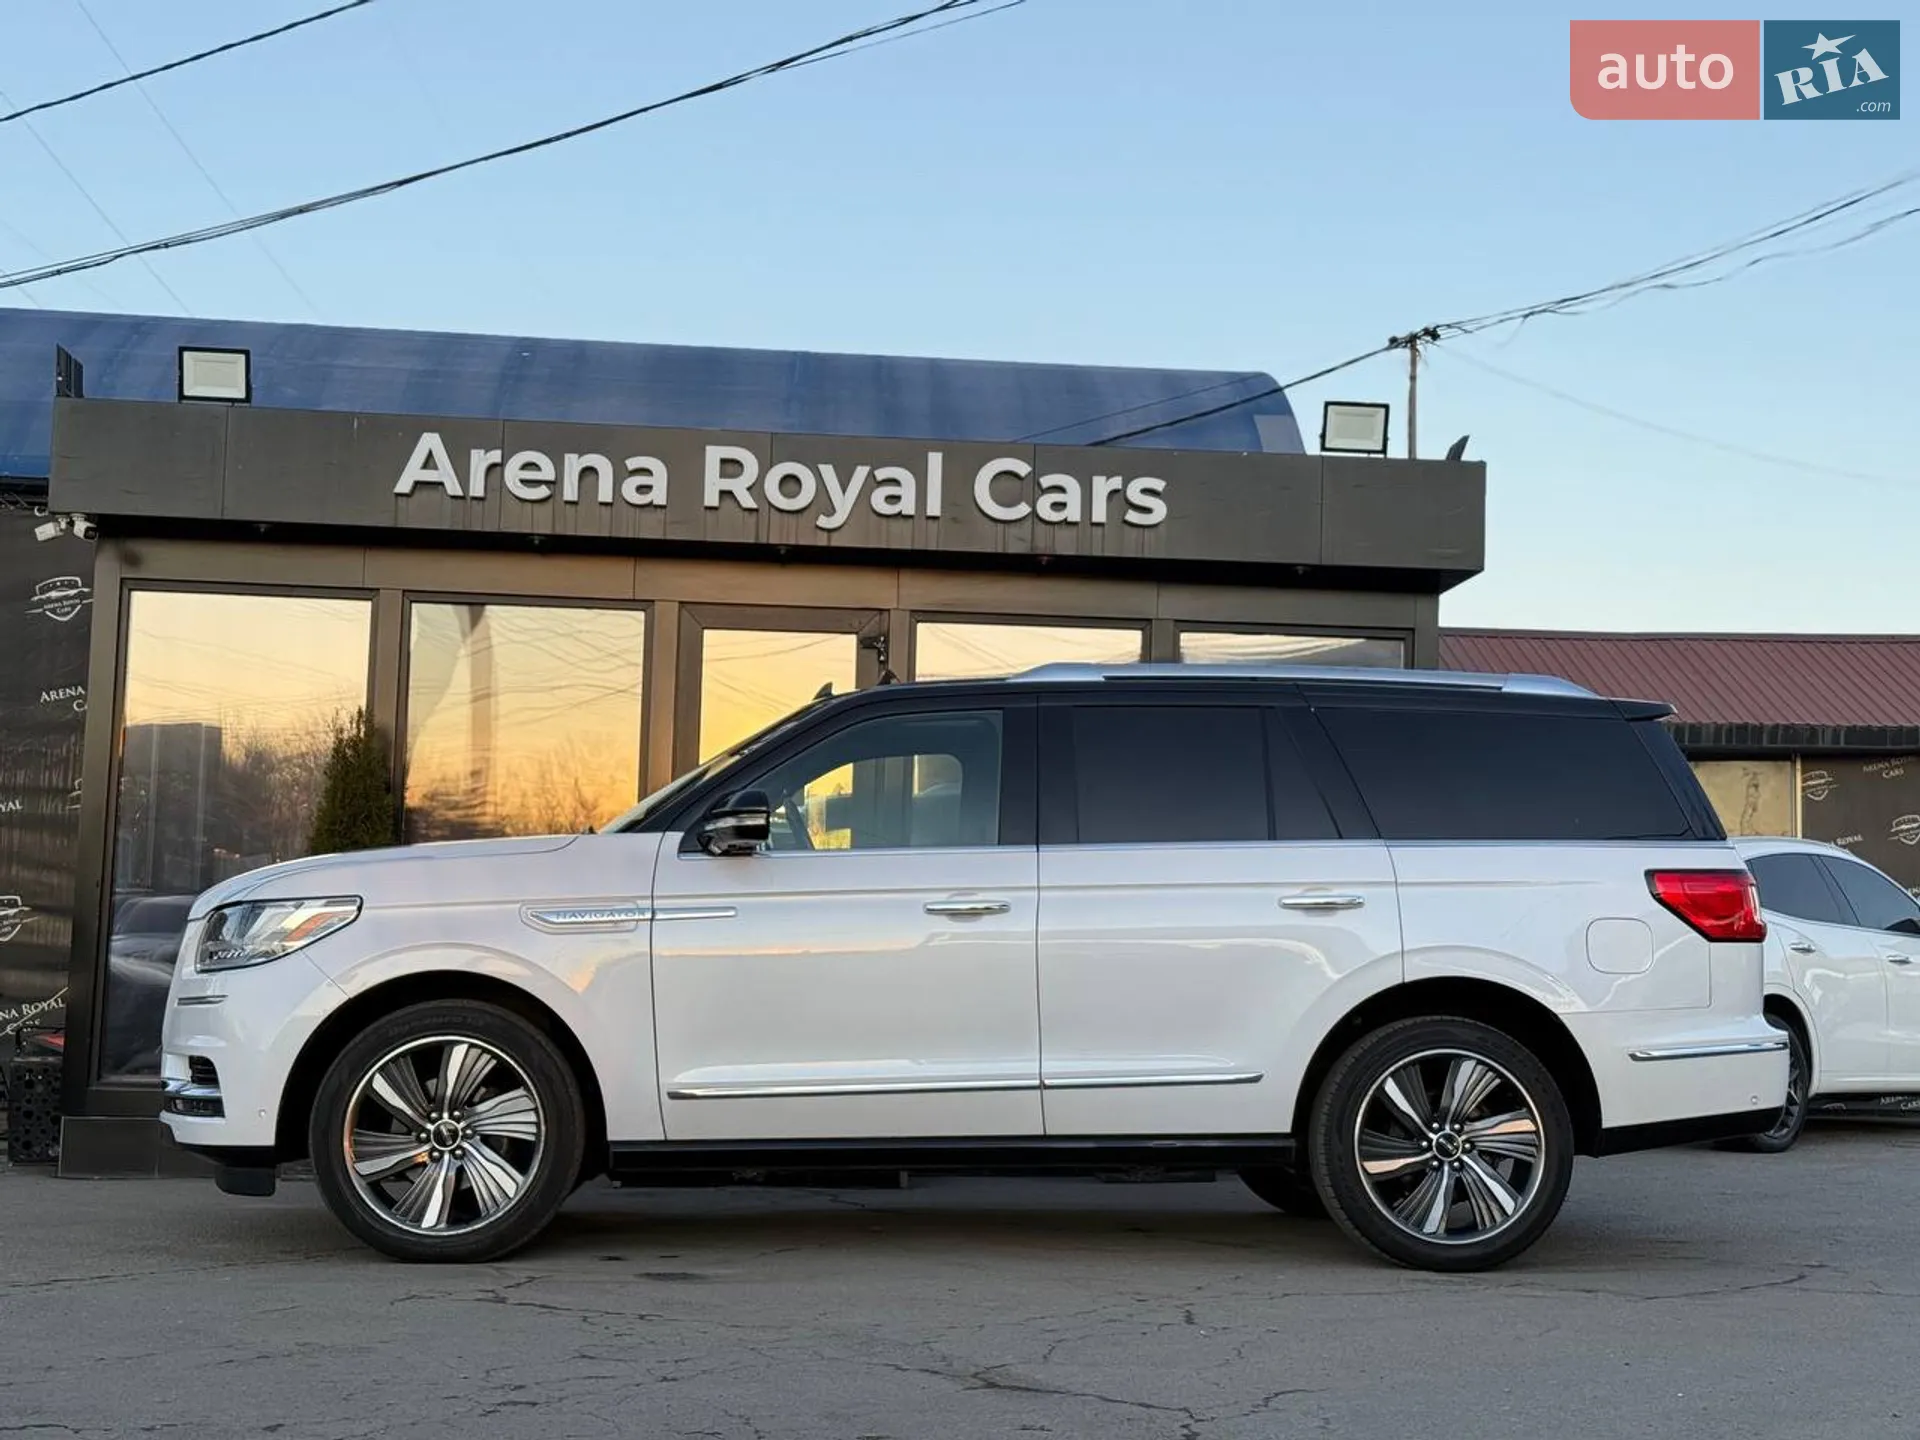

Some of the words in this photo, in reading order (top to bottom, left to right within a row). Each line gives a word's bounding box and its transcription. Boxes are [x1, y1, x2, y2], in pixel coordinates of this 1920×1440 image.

[393, 432, 668, 507] Arena
[703, 445, 944, 532] Royal
[973, 457, 1168, 527] Cars
[40, 685, 86, 703] ARENA
[556, 908, 649, 920] NAVIGATOR
[22, 997, 66, 1016] ROYAL
